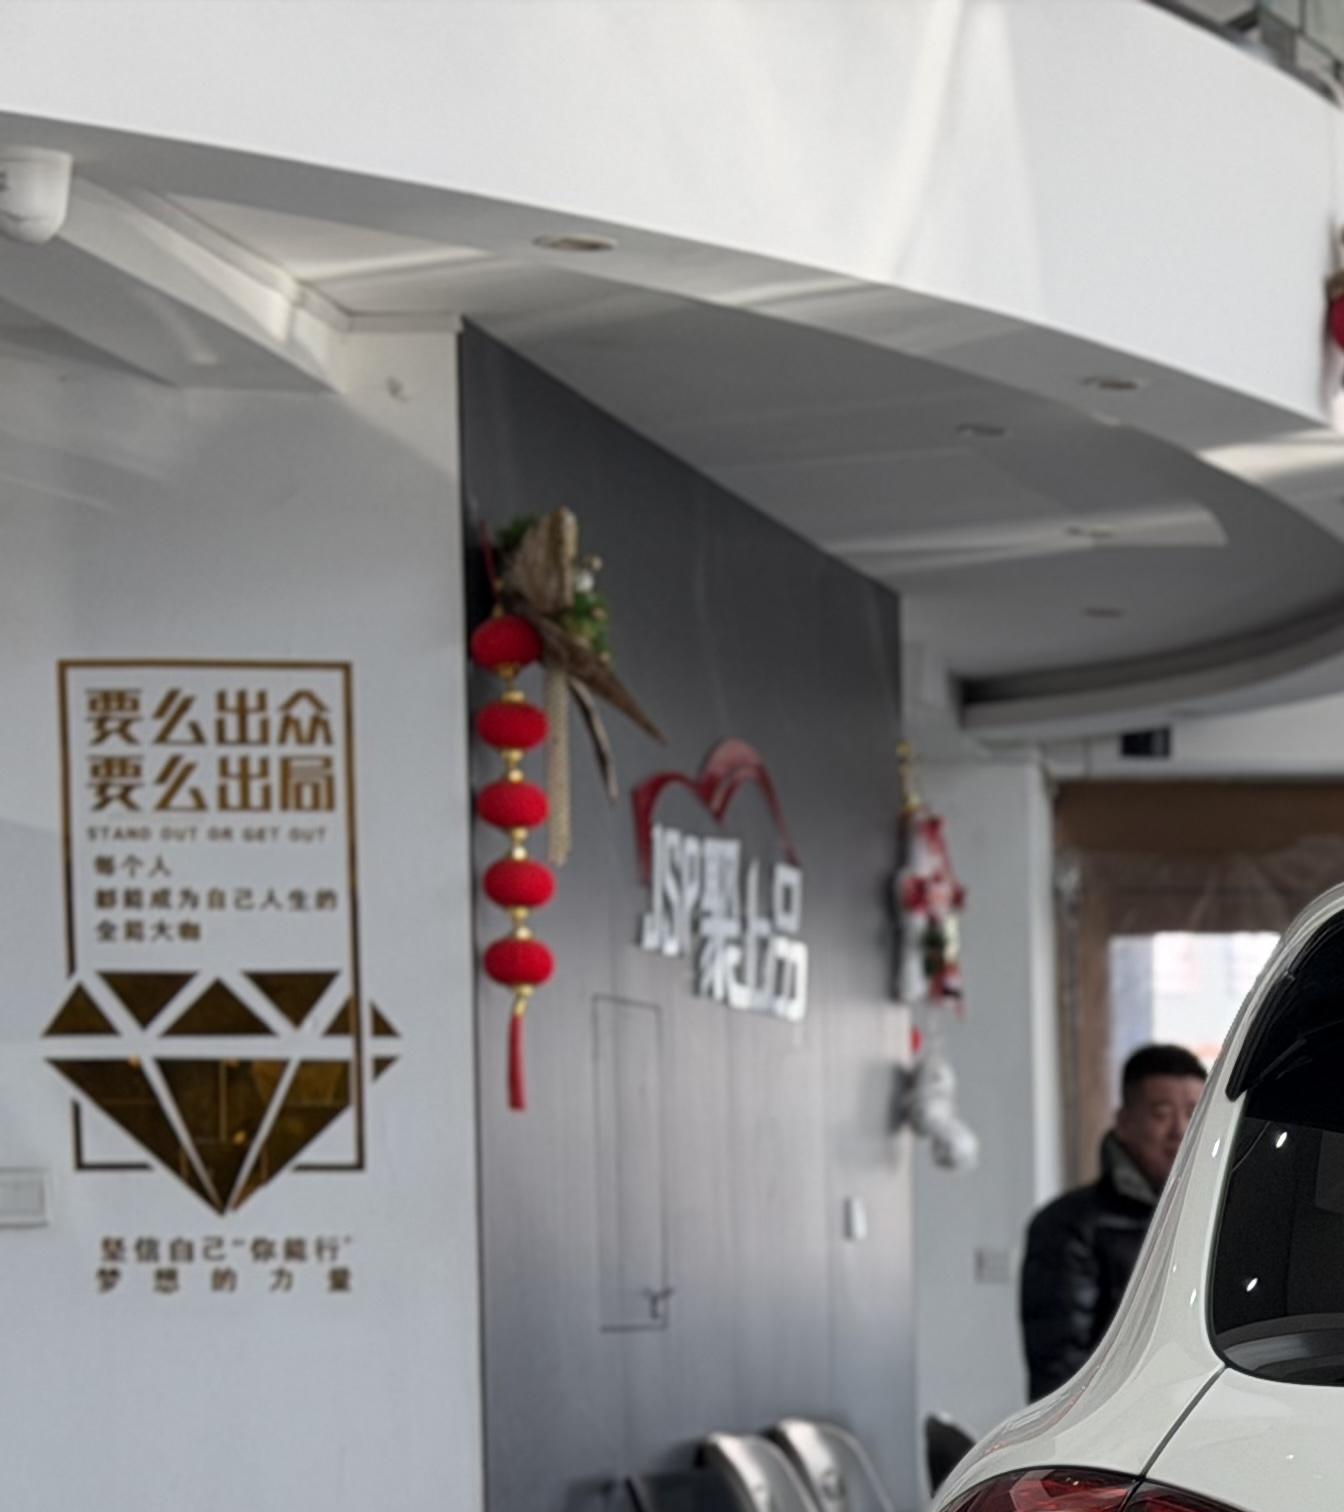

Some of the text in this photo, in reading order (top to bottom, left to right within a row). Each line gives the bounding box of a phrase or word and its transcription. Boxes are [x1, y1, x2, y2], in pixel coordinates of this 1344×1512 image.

[85, 687, 335, 747] 要么出众
[85, 754, 336, 813] 要么出局
[87, 826, 327, 843] STAND OUT OR GET OUT
[94, 854, 172, 879] 每个人
[95, 1266, 352, 1294] 梦想的力量
